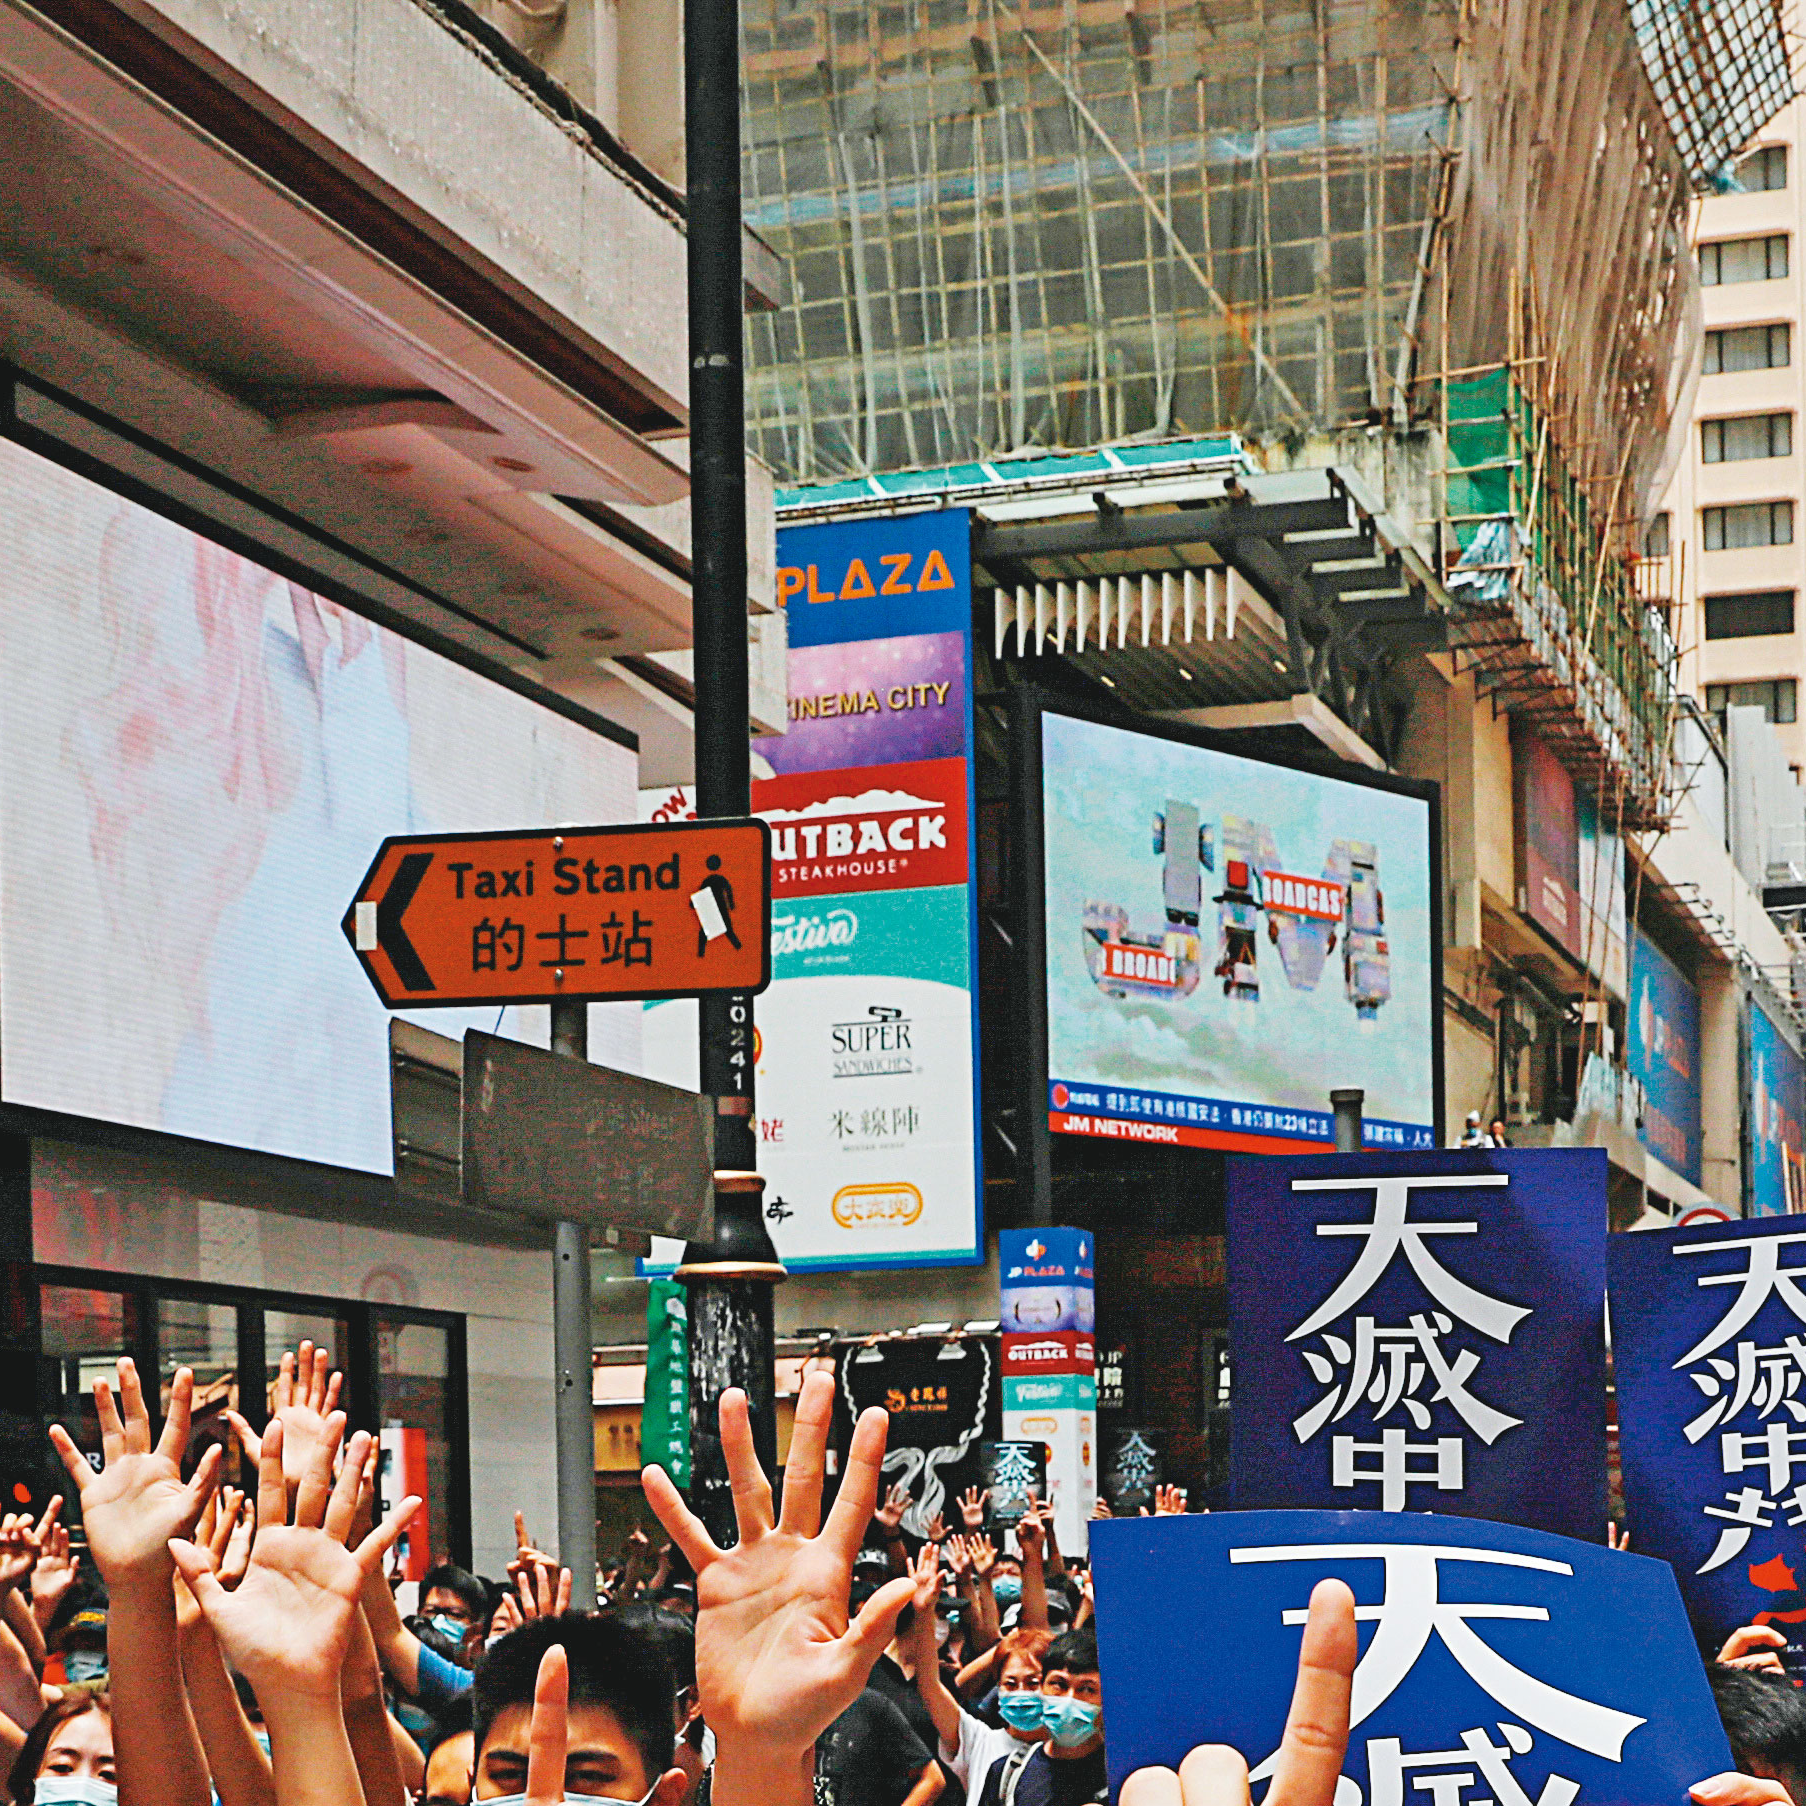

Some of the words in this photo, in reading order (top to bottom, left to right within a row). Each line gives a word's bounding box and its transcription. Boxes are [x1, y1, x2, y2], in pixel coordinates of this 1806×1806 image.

[776, 550, 956, 607] PLAZA
[787, 690, 880, 721] INEMA
[887, 681, 950, 710] CITY
[771, 815, 946, 860] UTBACK
[447, 860, 534, 900] Taxi
[553, 853, 681, 896] Stand
[778, 859, 897, 882] STEAKHOUSE
[471, 910, 654, 972] 的士站
[771, 909, 858, 956] estiva
[832, 1024, 912, 1053] SUPER
[827, 1106, 920, 1139] 米線陣
[1063, 1115, 1090, 1132] JM
[1094, 1118, 1178, 1142] NETWORK
[1008, 1349, 1068, 1361] OUTBACK
[1284, 1174, 1534, 1512] 天滅中
